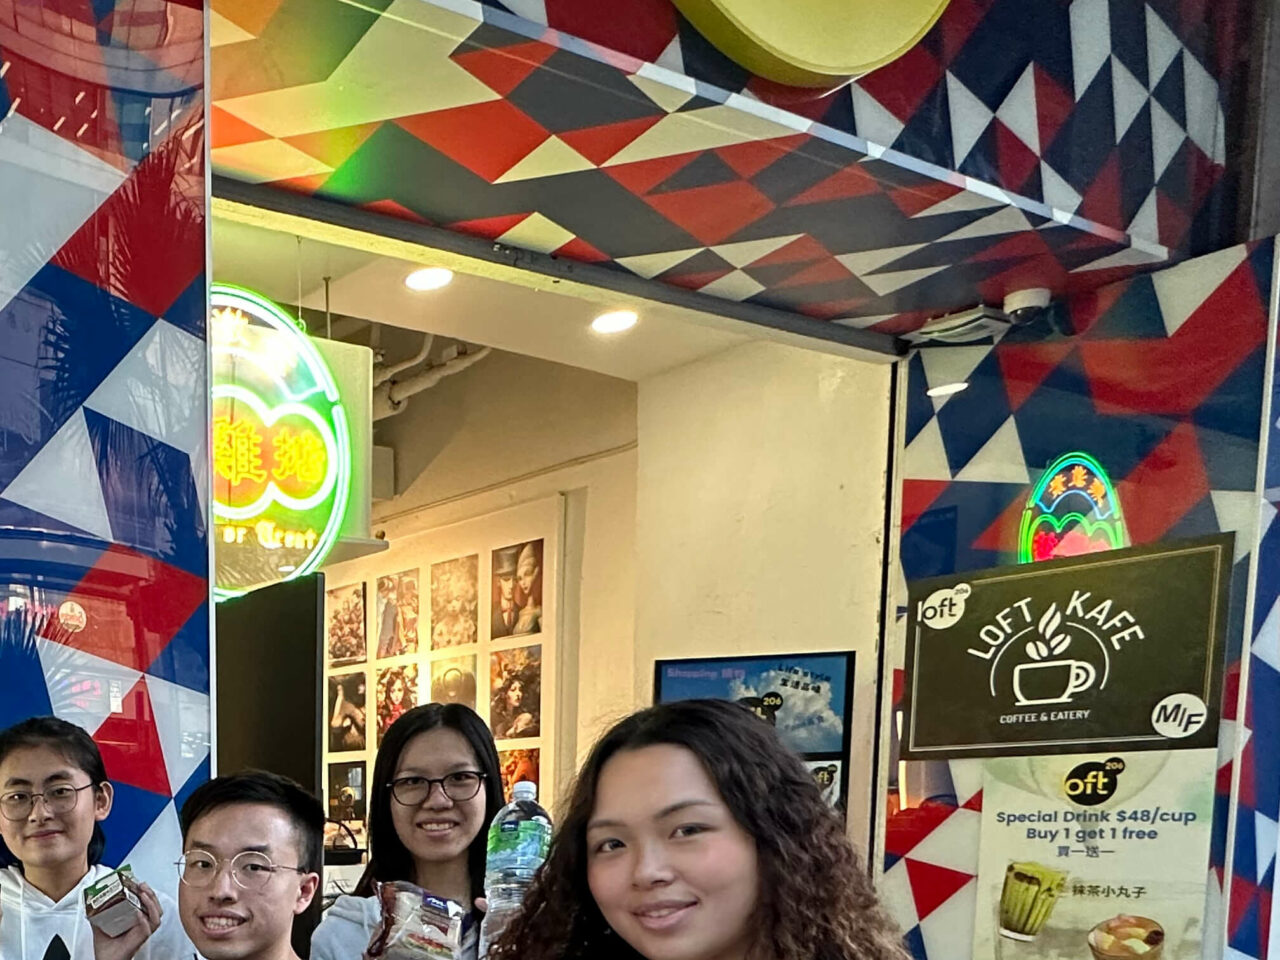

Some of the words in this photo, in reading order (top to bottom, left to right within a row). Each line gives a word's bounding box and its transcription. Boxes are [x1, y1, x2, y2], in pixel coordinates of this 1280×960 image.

[967, 597, 1033, 660] LOFT
[1066, 590, 1145, 650] KAFE
[763, 696, 782, 706] 206
[999, 712, 1038, 724] COFFEE
[1040, 712, 1048, 722] &
[1050, 710, 1091, 721] EATERY
[1105, 761, 1124, 770] 206
[996, 810, 1058, 826] Special
[1063, 810, 1110, 823] Drink
[1116, 806, 1197, 826] $48/cup
[1026, 828, 1058, 842] Buy
[1064, 828, 1069, 839] 1
[1075, 828, 1105, 842] get
[1111, 827, 1116, 838] 1
[1122, 827, 1158, 840] free
[1057, 845, 1115, 858] 買一送一
[1072, 884, 1147, 899] 抹茶小丸子
